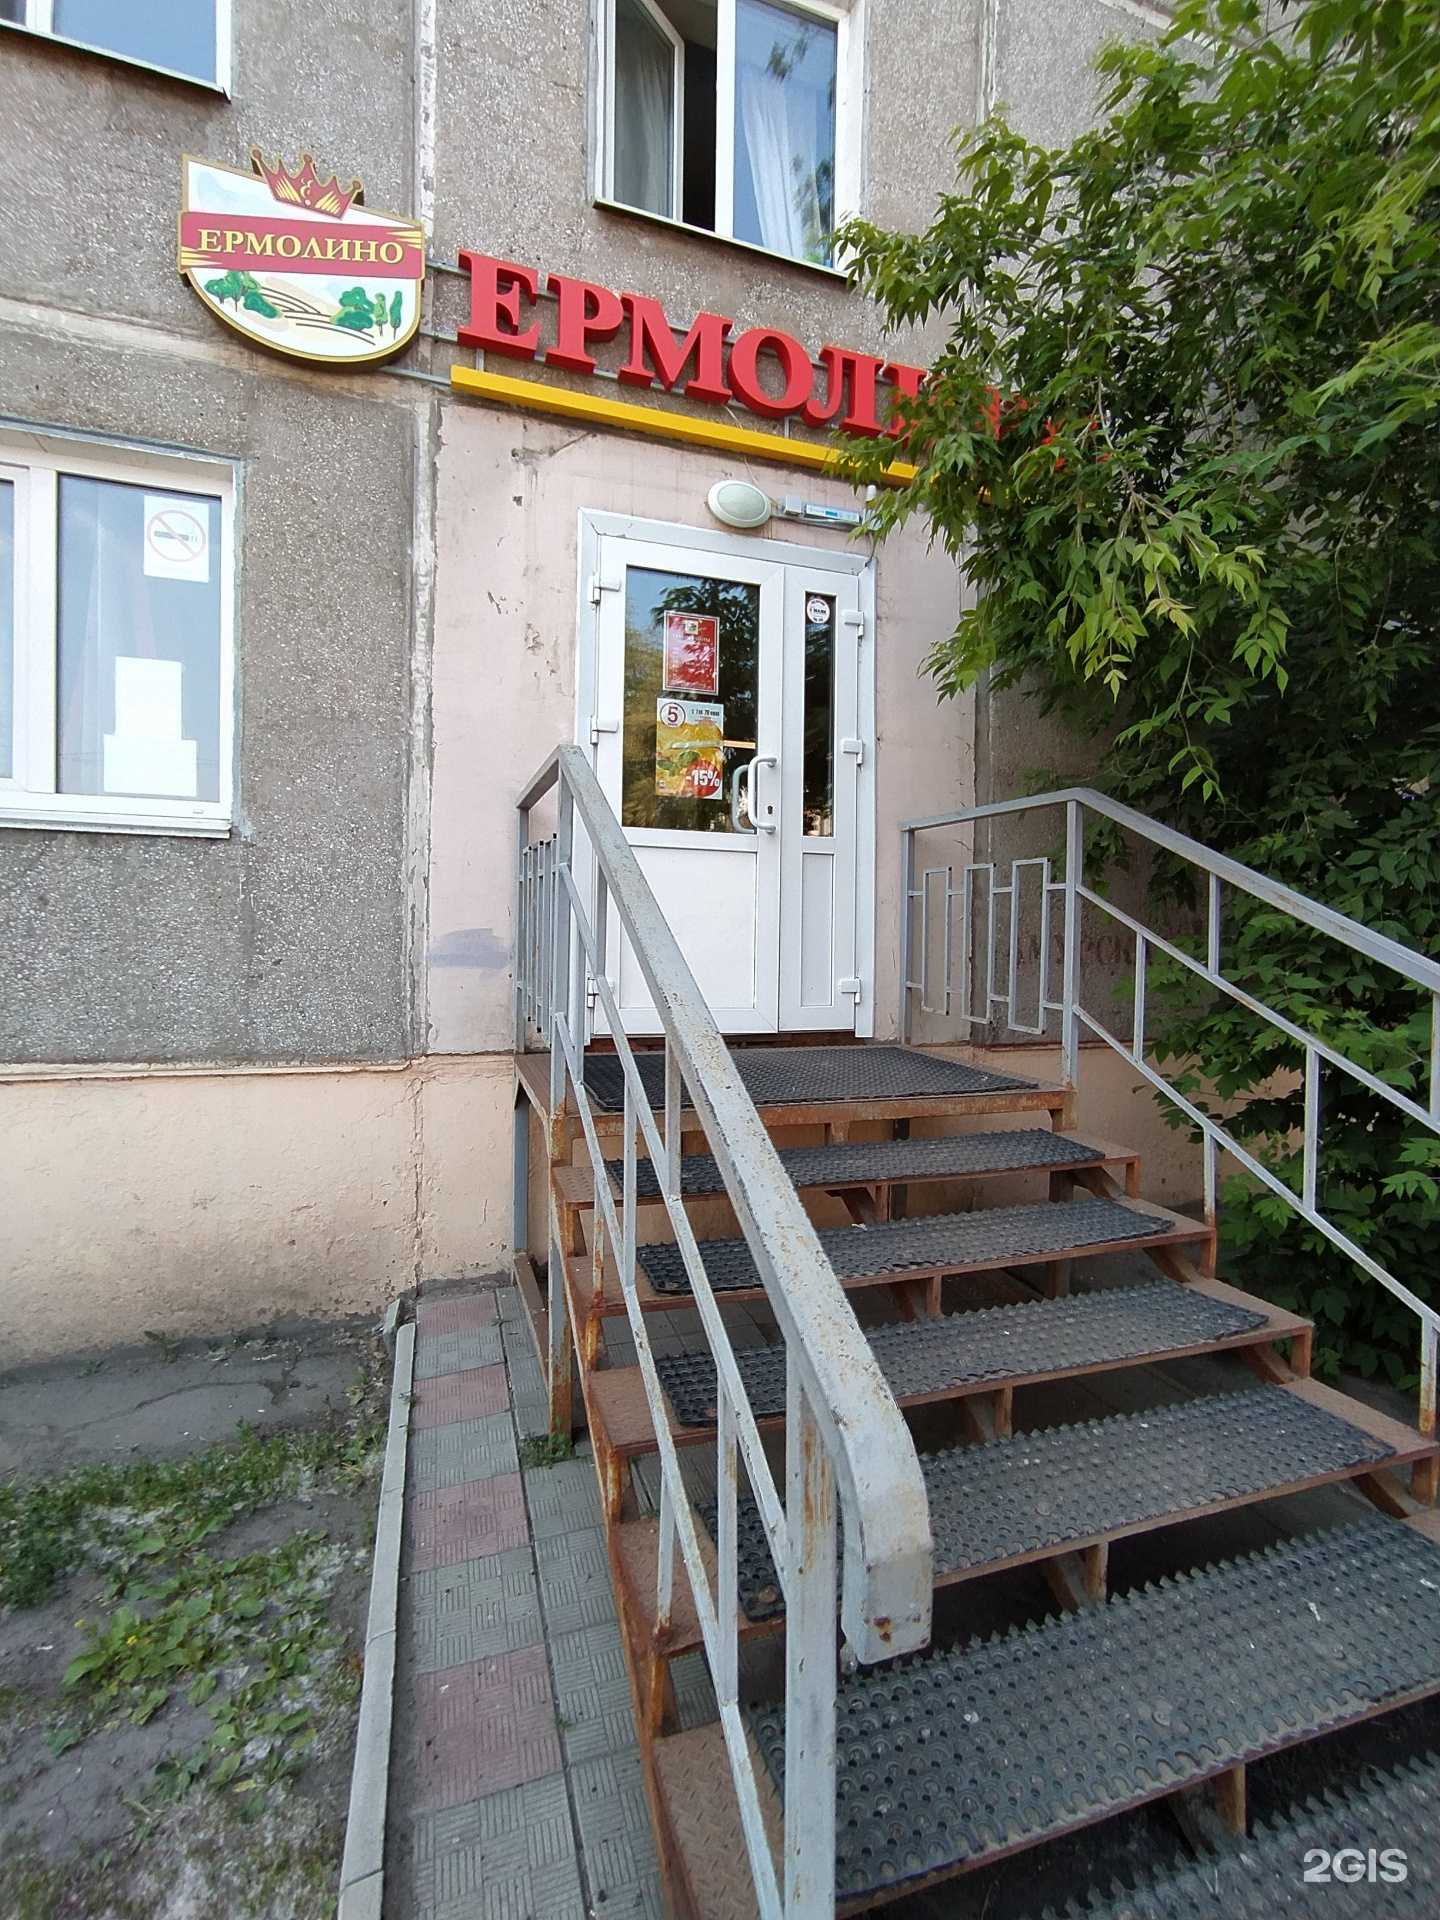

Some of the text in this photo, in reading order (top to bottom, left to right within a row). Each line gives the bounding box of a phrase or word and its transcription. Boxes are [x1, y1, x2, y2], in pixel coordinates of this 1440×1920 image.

[197, 228, 404, 264] ЕРМОЛИНО
[667, 705, 679, 723] 5
[685, 768, 720, 788] -15%
